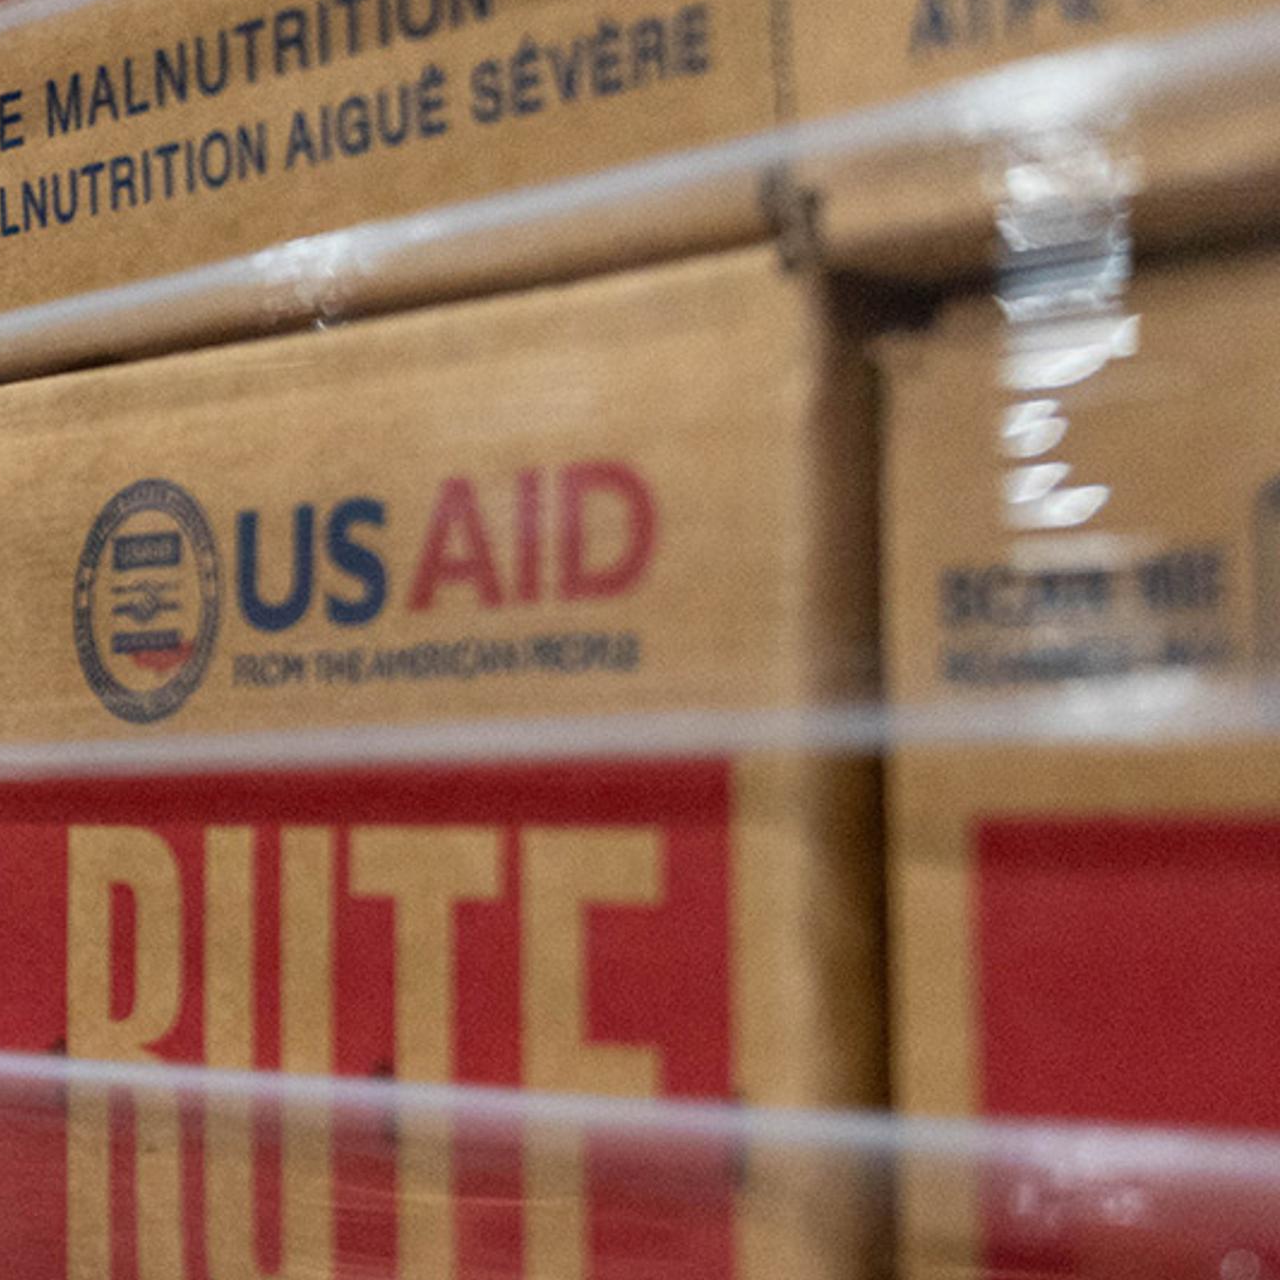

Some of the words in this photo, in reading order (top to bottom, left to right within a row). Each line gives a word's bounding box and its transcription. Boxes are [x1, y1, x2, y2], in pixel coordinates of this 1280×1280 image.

[236, 461, 659, 631] USAID
[233, 651, 305, 688] FROM
[315, 649, 362, 685] THE
